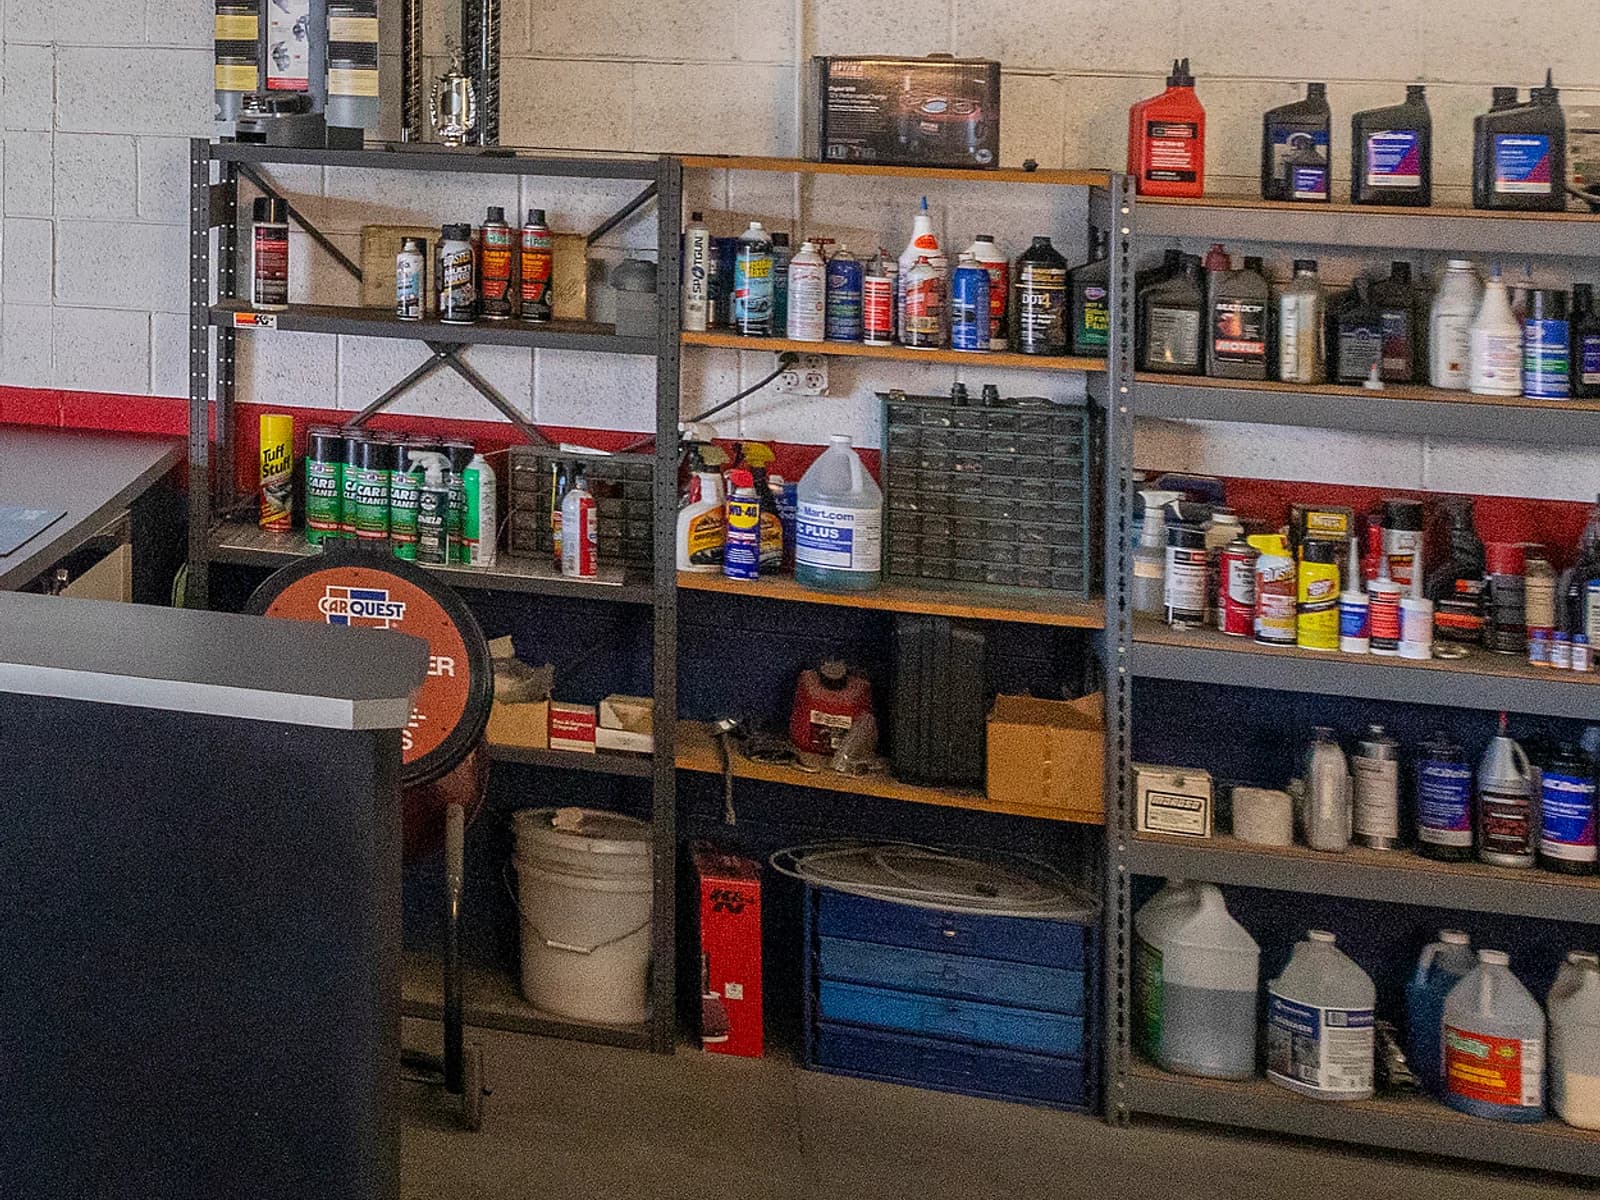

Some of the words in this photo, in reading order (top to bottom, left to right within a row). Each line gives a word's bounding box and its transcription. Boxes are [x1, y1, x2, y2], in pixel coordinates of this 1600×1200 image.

[263, 444, 285, 463] Tuff
[262, 455, 291, 479] Stuff
[729, 505, 758, 517] WD-40
[805, 524, 840, 540] PLUS
[319, 598, 405, 618] CARQUEST
